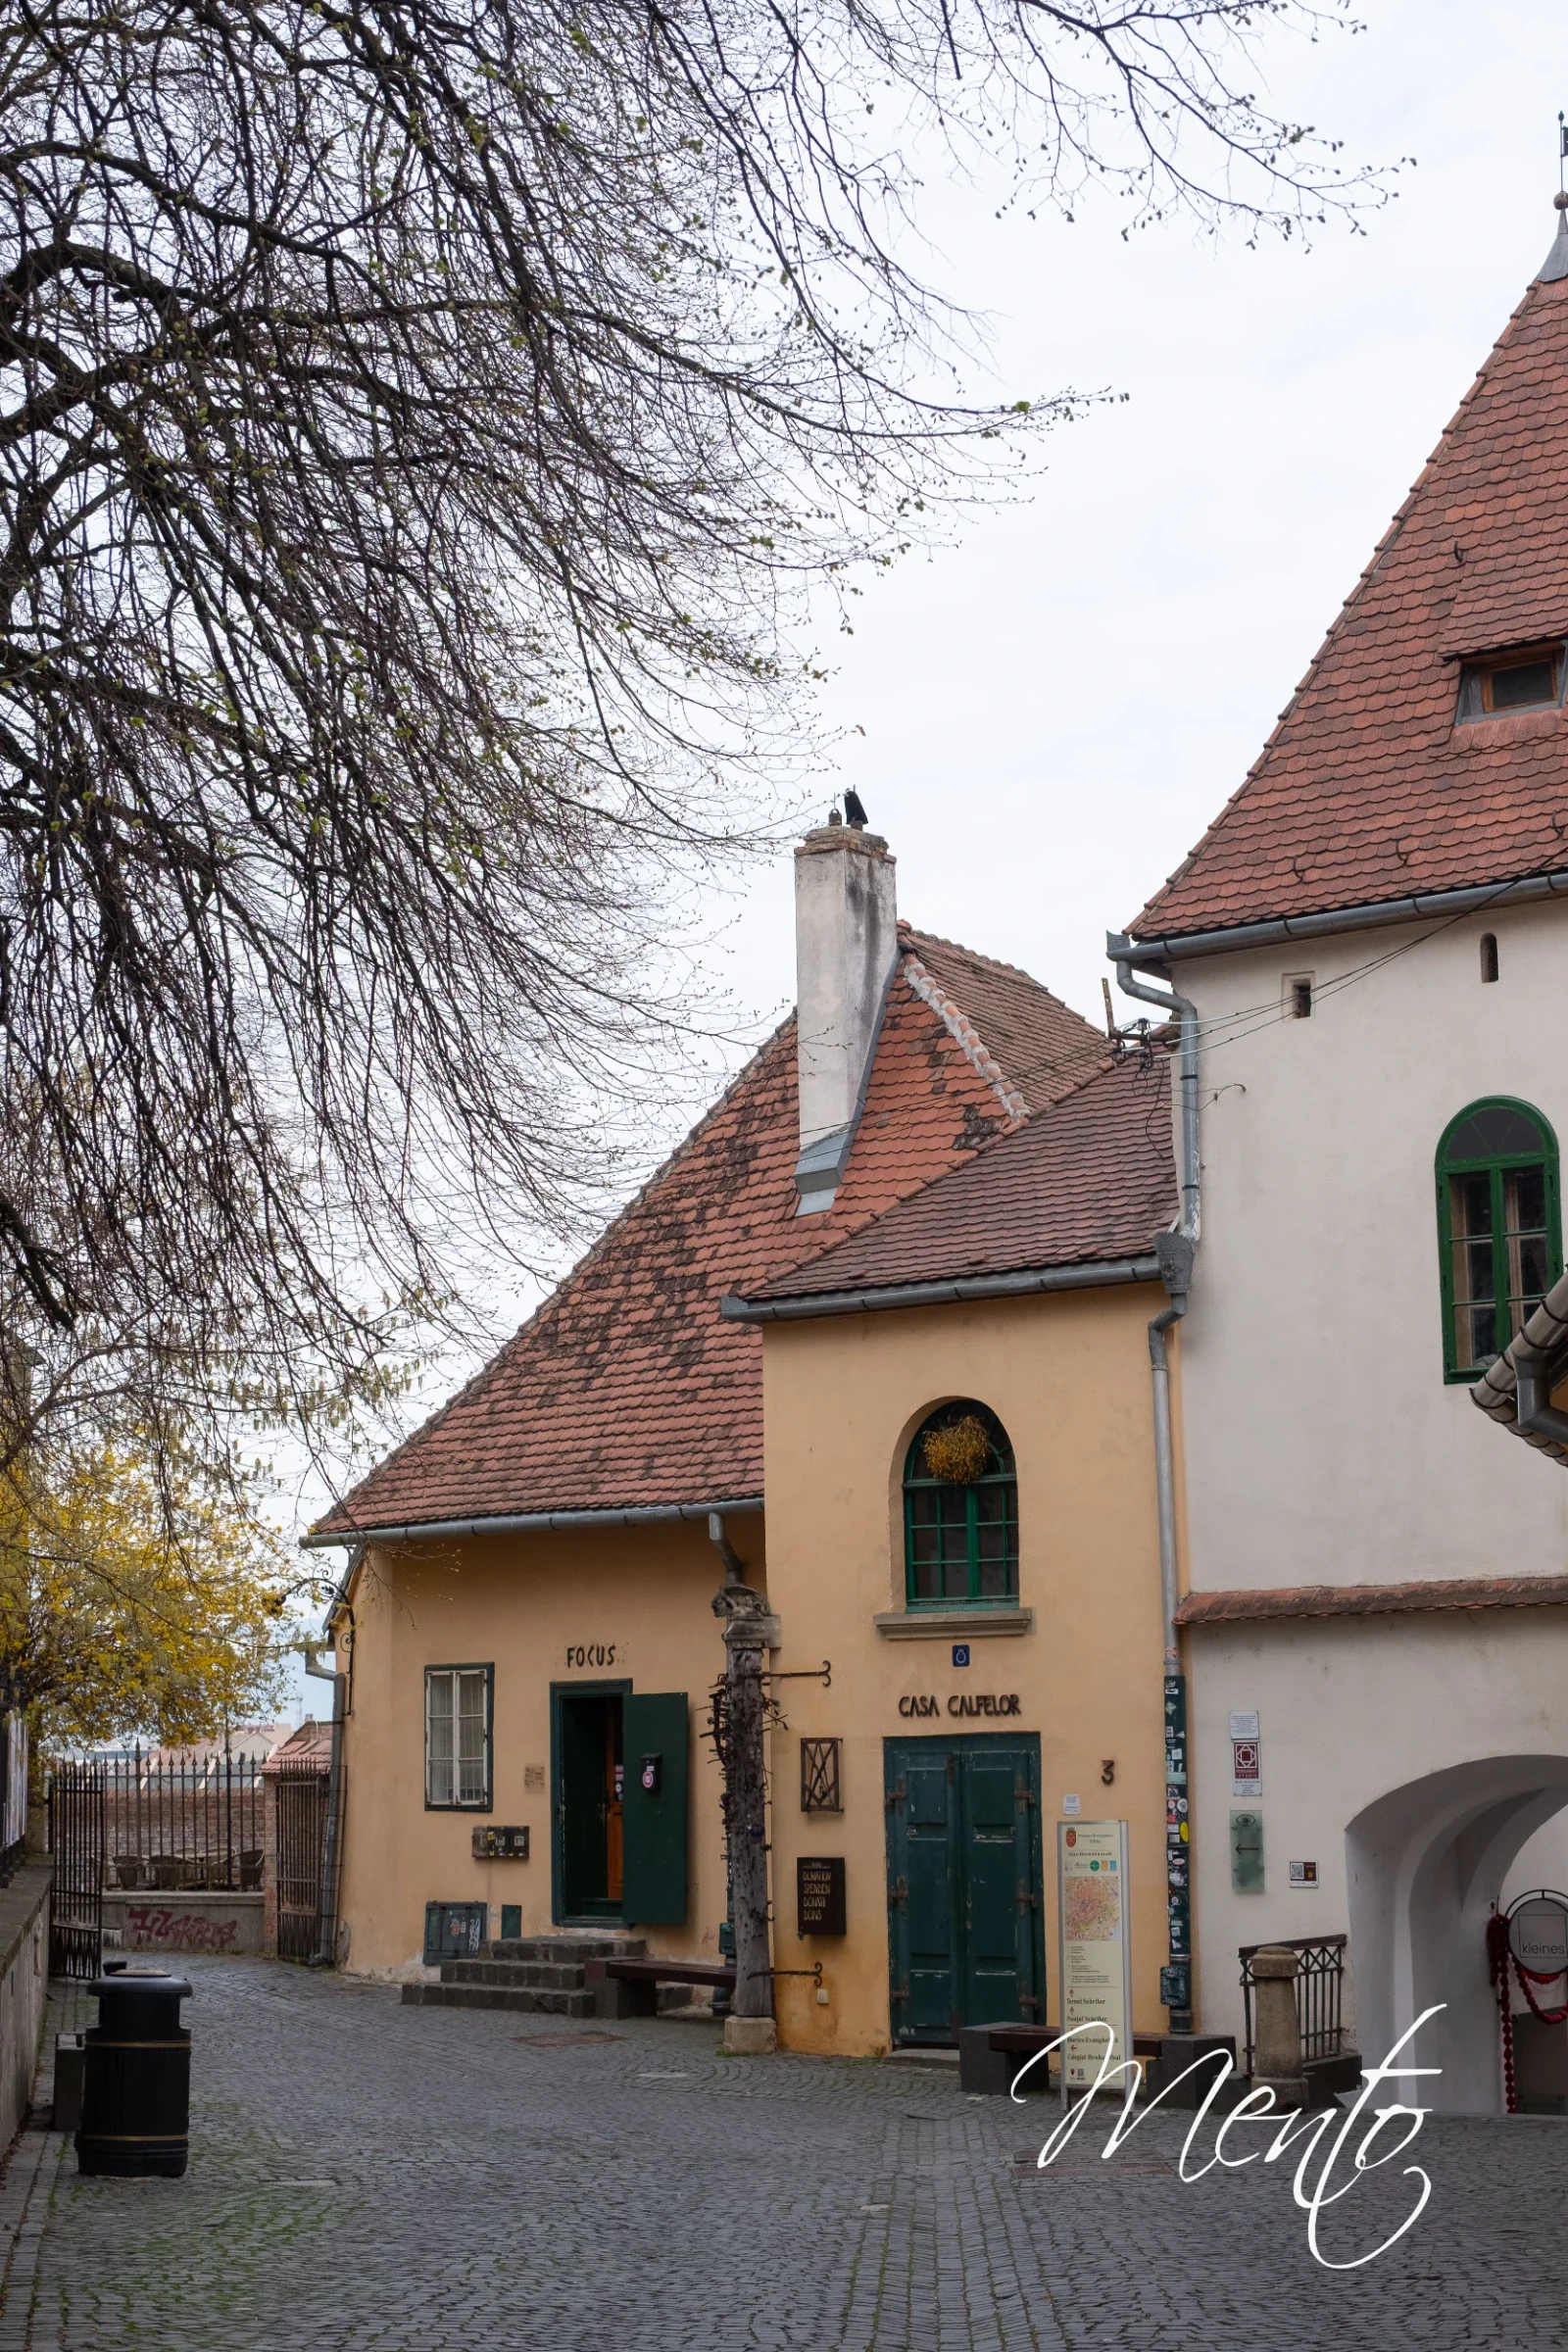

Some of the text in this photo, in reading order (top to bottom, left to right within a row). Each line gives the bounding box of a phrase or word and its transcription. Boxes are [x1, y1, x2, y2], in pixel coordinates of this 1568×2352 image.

[566, 1644, 616, 1668] FOCUS
[899, 1693, 1022, 1718] CASA CALFELOR
[1100, 1759, 1115, 1786] 3
[804, 1884, 831, 1894] SPENDEN
[804, 1909, 822, 1920] DONS
[1522, 1942, 1565, 1955] kleines
